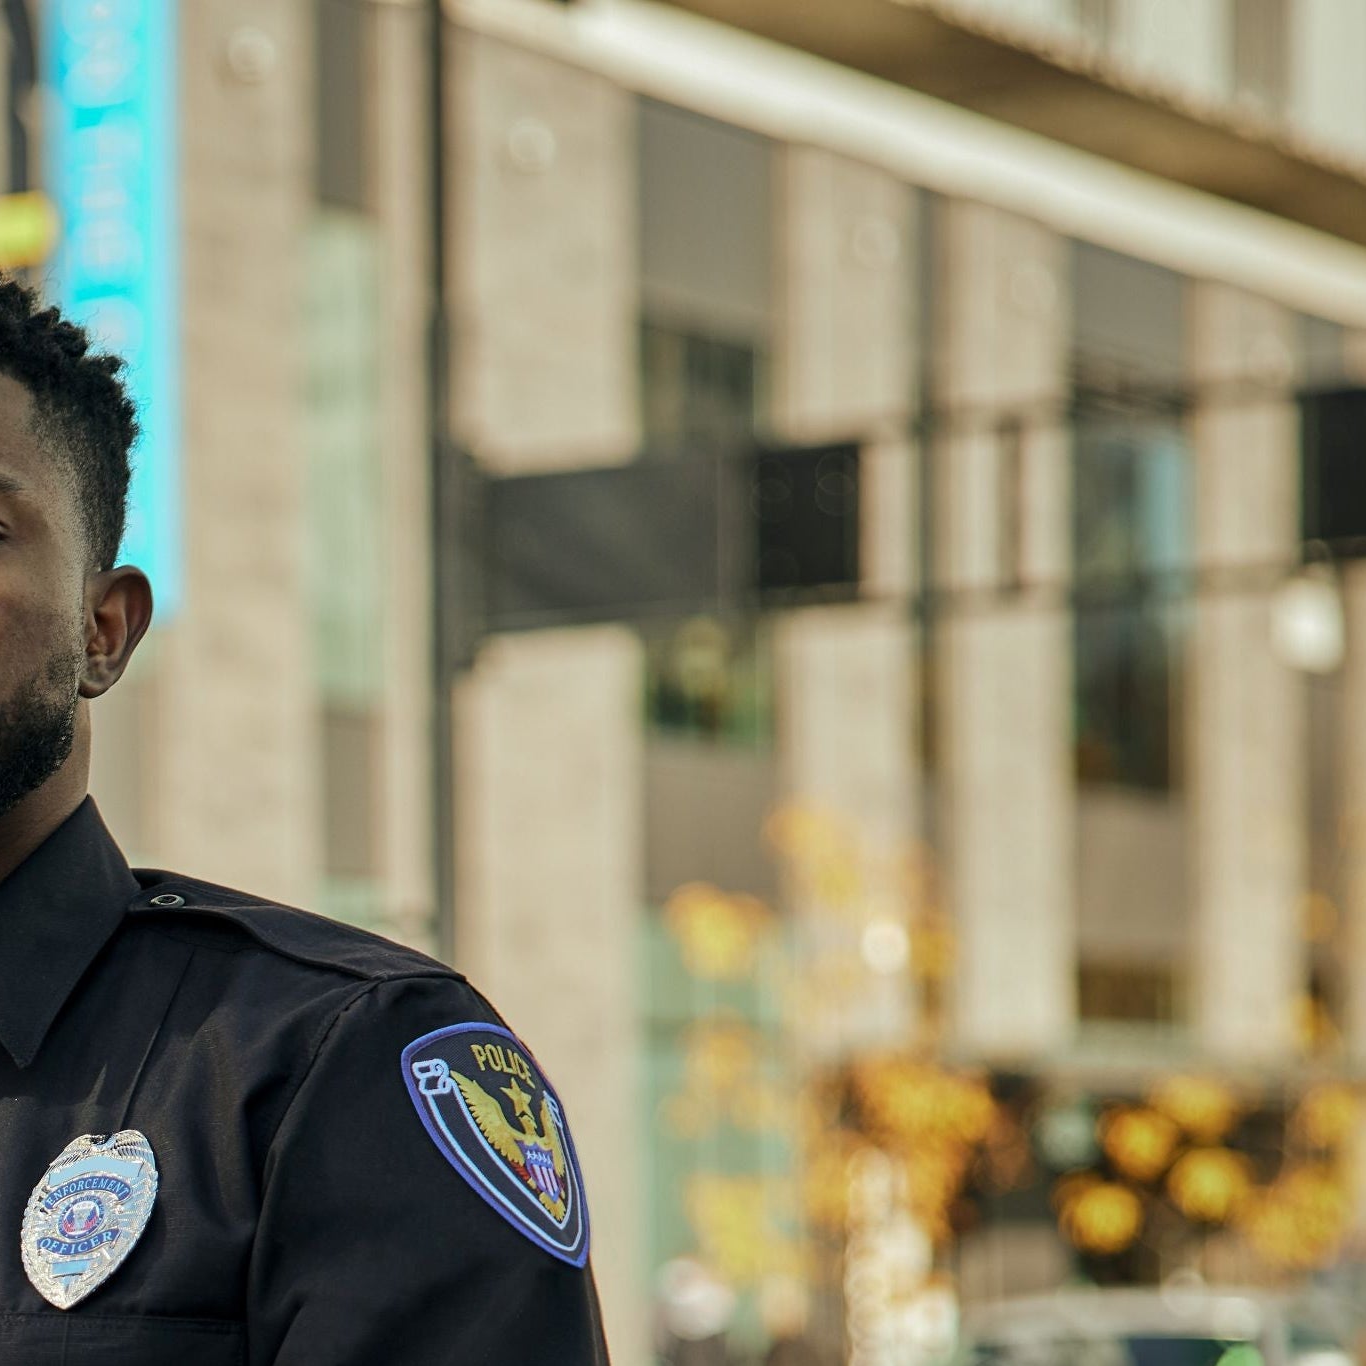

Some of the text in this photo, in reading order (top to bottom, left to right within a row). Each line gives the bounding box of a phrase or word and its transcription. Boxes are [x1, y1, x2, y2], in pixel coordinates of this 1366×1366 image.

[470, 1044, 536, 1088] POLICE
[46, 1177, 130, 1206] ENFORCEMENT
[40, 1231, 113, 1255] OFFICER
